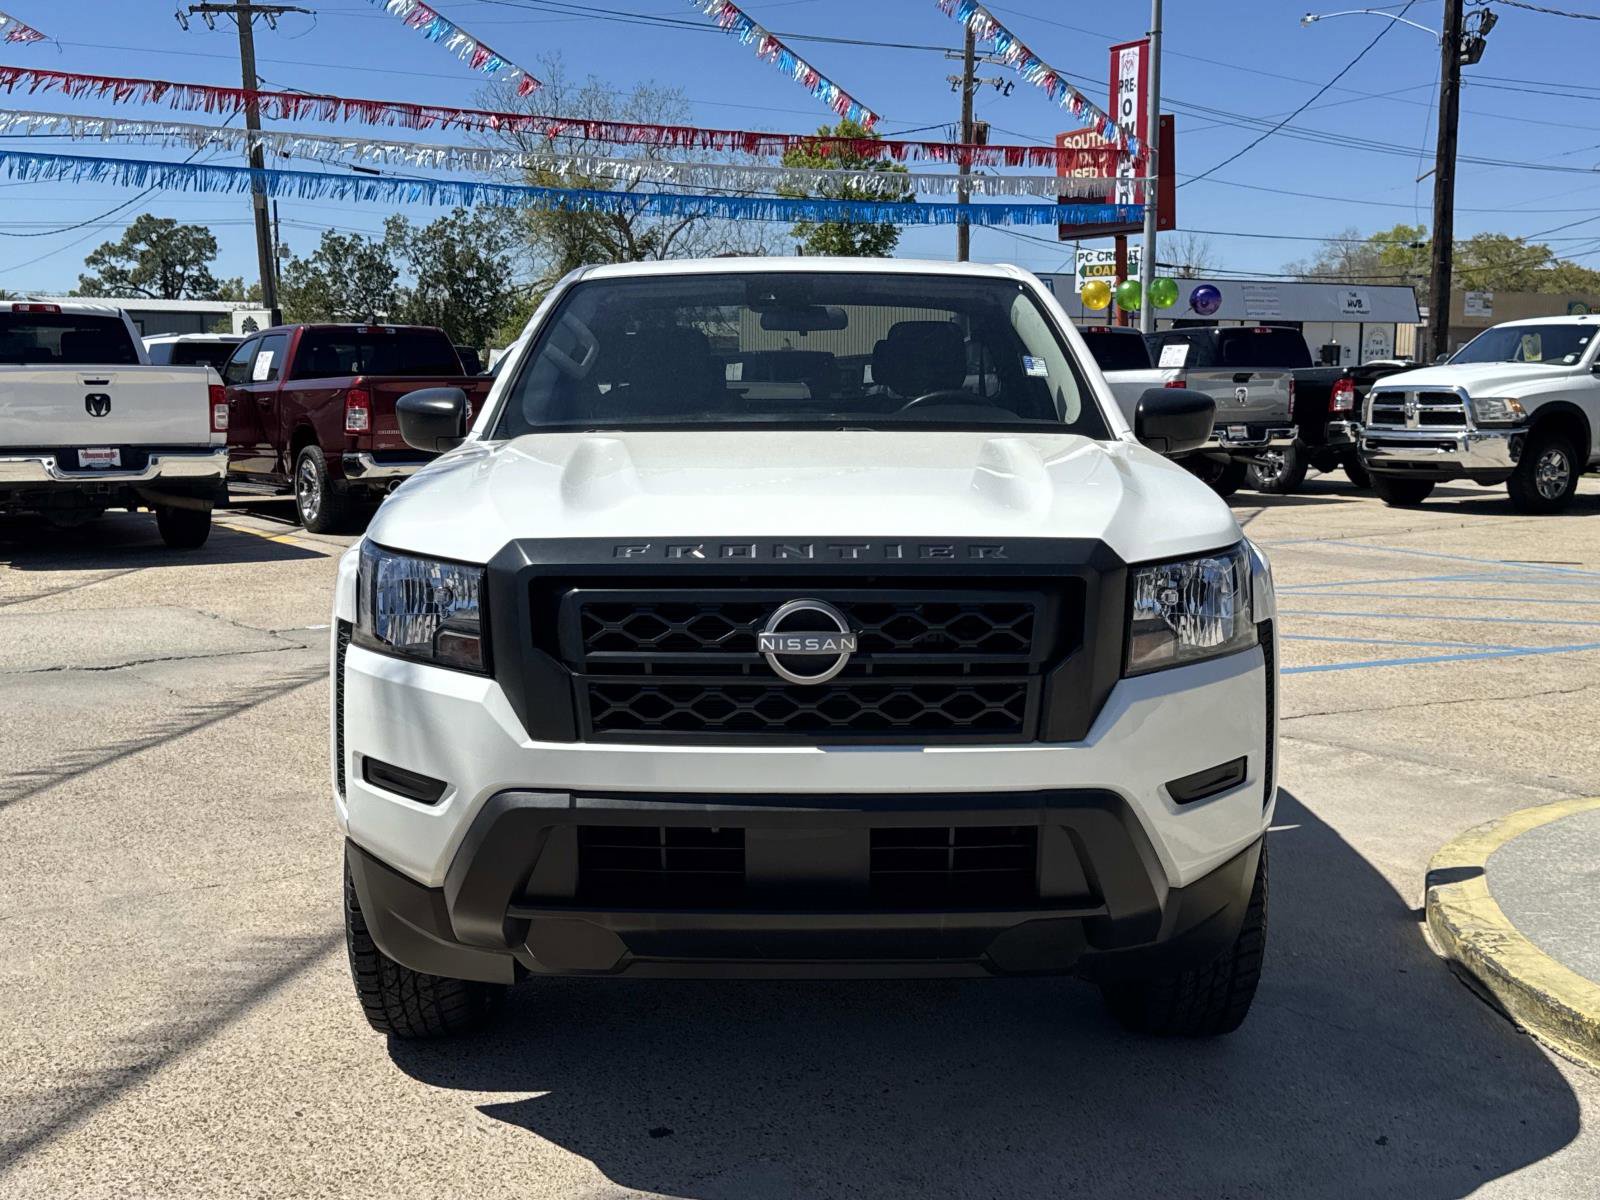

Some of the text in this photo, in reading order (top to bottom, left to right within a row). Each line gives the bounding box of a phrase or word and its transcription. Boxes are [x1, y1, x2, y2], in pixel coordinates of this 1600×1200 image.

[1117, 78, 1137, 94] PRE-
[1078, 249, 1139, 263] PC CRIT
[612, 543, 1008, 560] FRONTIER
[760, 637, 856, 651] NISSAN
